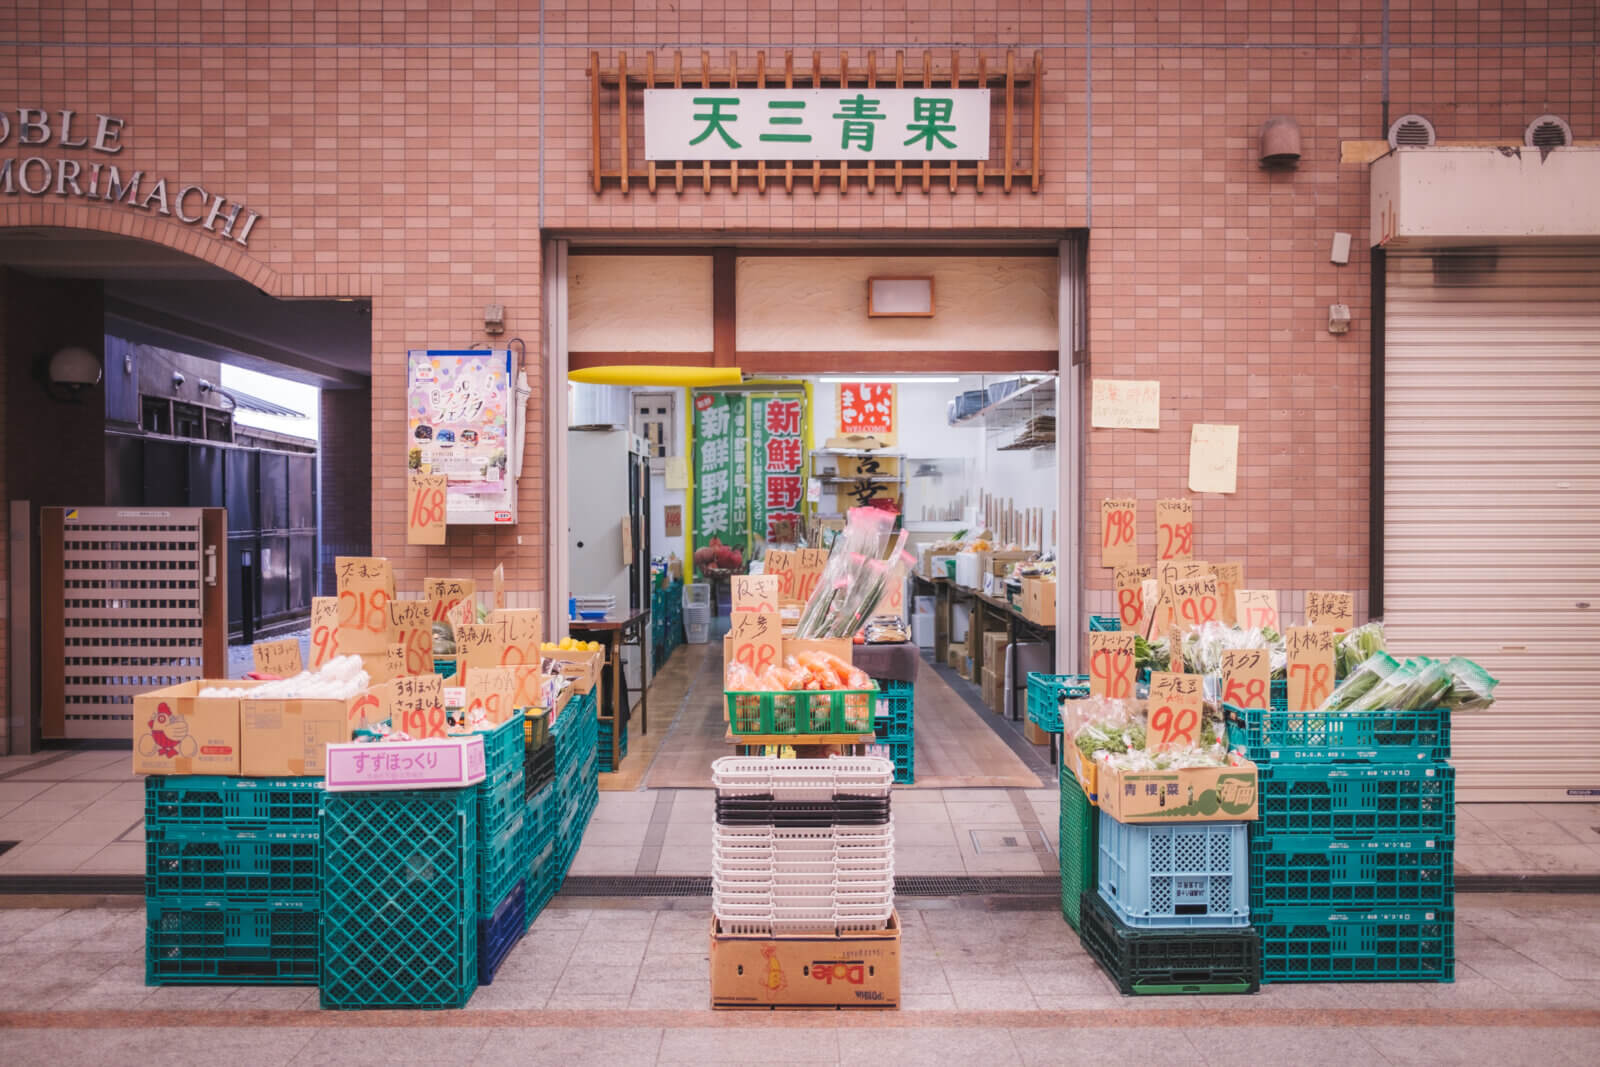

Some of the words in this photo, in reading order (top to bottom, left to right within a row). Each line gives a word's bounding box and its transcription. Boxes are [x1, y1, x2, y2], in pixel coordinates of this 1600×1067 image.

[689, 94, 958, 152] 天三青果
[701, 405, 729, 537] 新鮮野菜
[410, 487, 444, 529] 168
[1103, 509, 1135, 549] 198
[1160, 521, 1193, 560] 258
[341, 562, 384, 579] たまご
[768, 568, 793, 595] 58
[736, 577, 775, 601] ねぎ
[339, 589, 388, 634] 218
[1182, 596, 1217, 625] 98
[457, 626, 496, 646] 青森りん
[736, 642, 776, 678] 98
[1091, 648, 1132, 699] 98
[1223, 652, 1261, 669] オクラ
[1224, 678, 1267, 709] 58
[1289, 663, 1330, 711] 78
[402, 706, 446, 740] 198
[1152, 706, 1199, 746] 98
[352, 752, 438, 774] すずほっくり
[1125, 783, 1179, 796] 青梗菜
[811, 964, 864, 984] Dole
